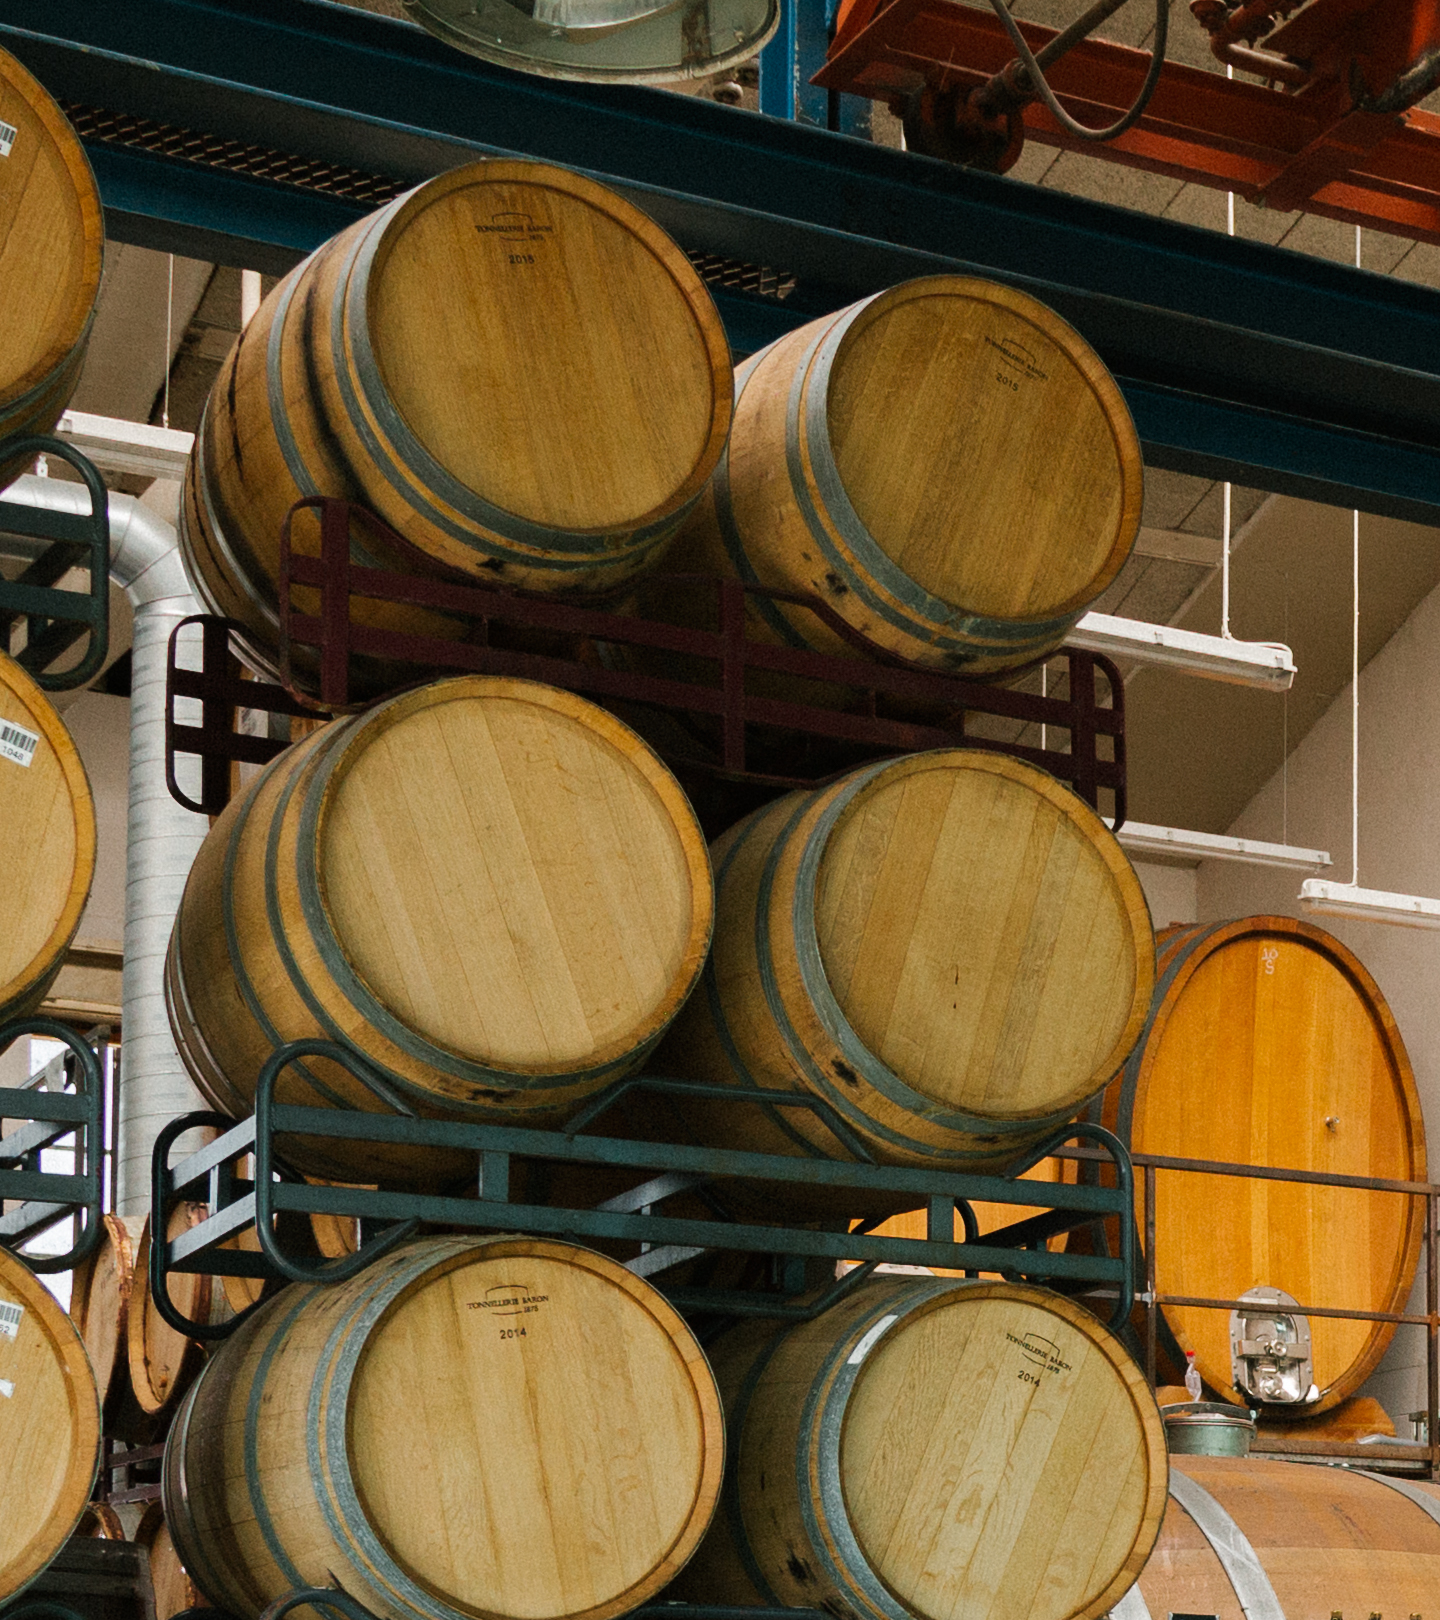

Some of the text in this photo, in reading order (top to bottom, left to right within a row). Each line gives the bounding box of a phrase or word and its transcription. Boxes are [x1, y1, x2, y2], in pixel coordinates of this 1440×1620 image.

[1, 745, 24, 762] 1048
[500, 1327, 527, 1340] 2014
[1018, 1370, 1040, 1387] 2014
